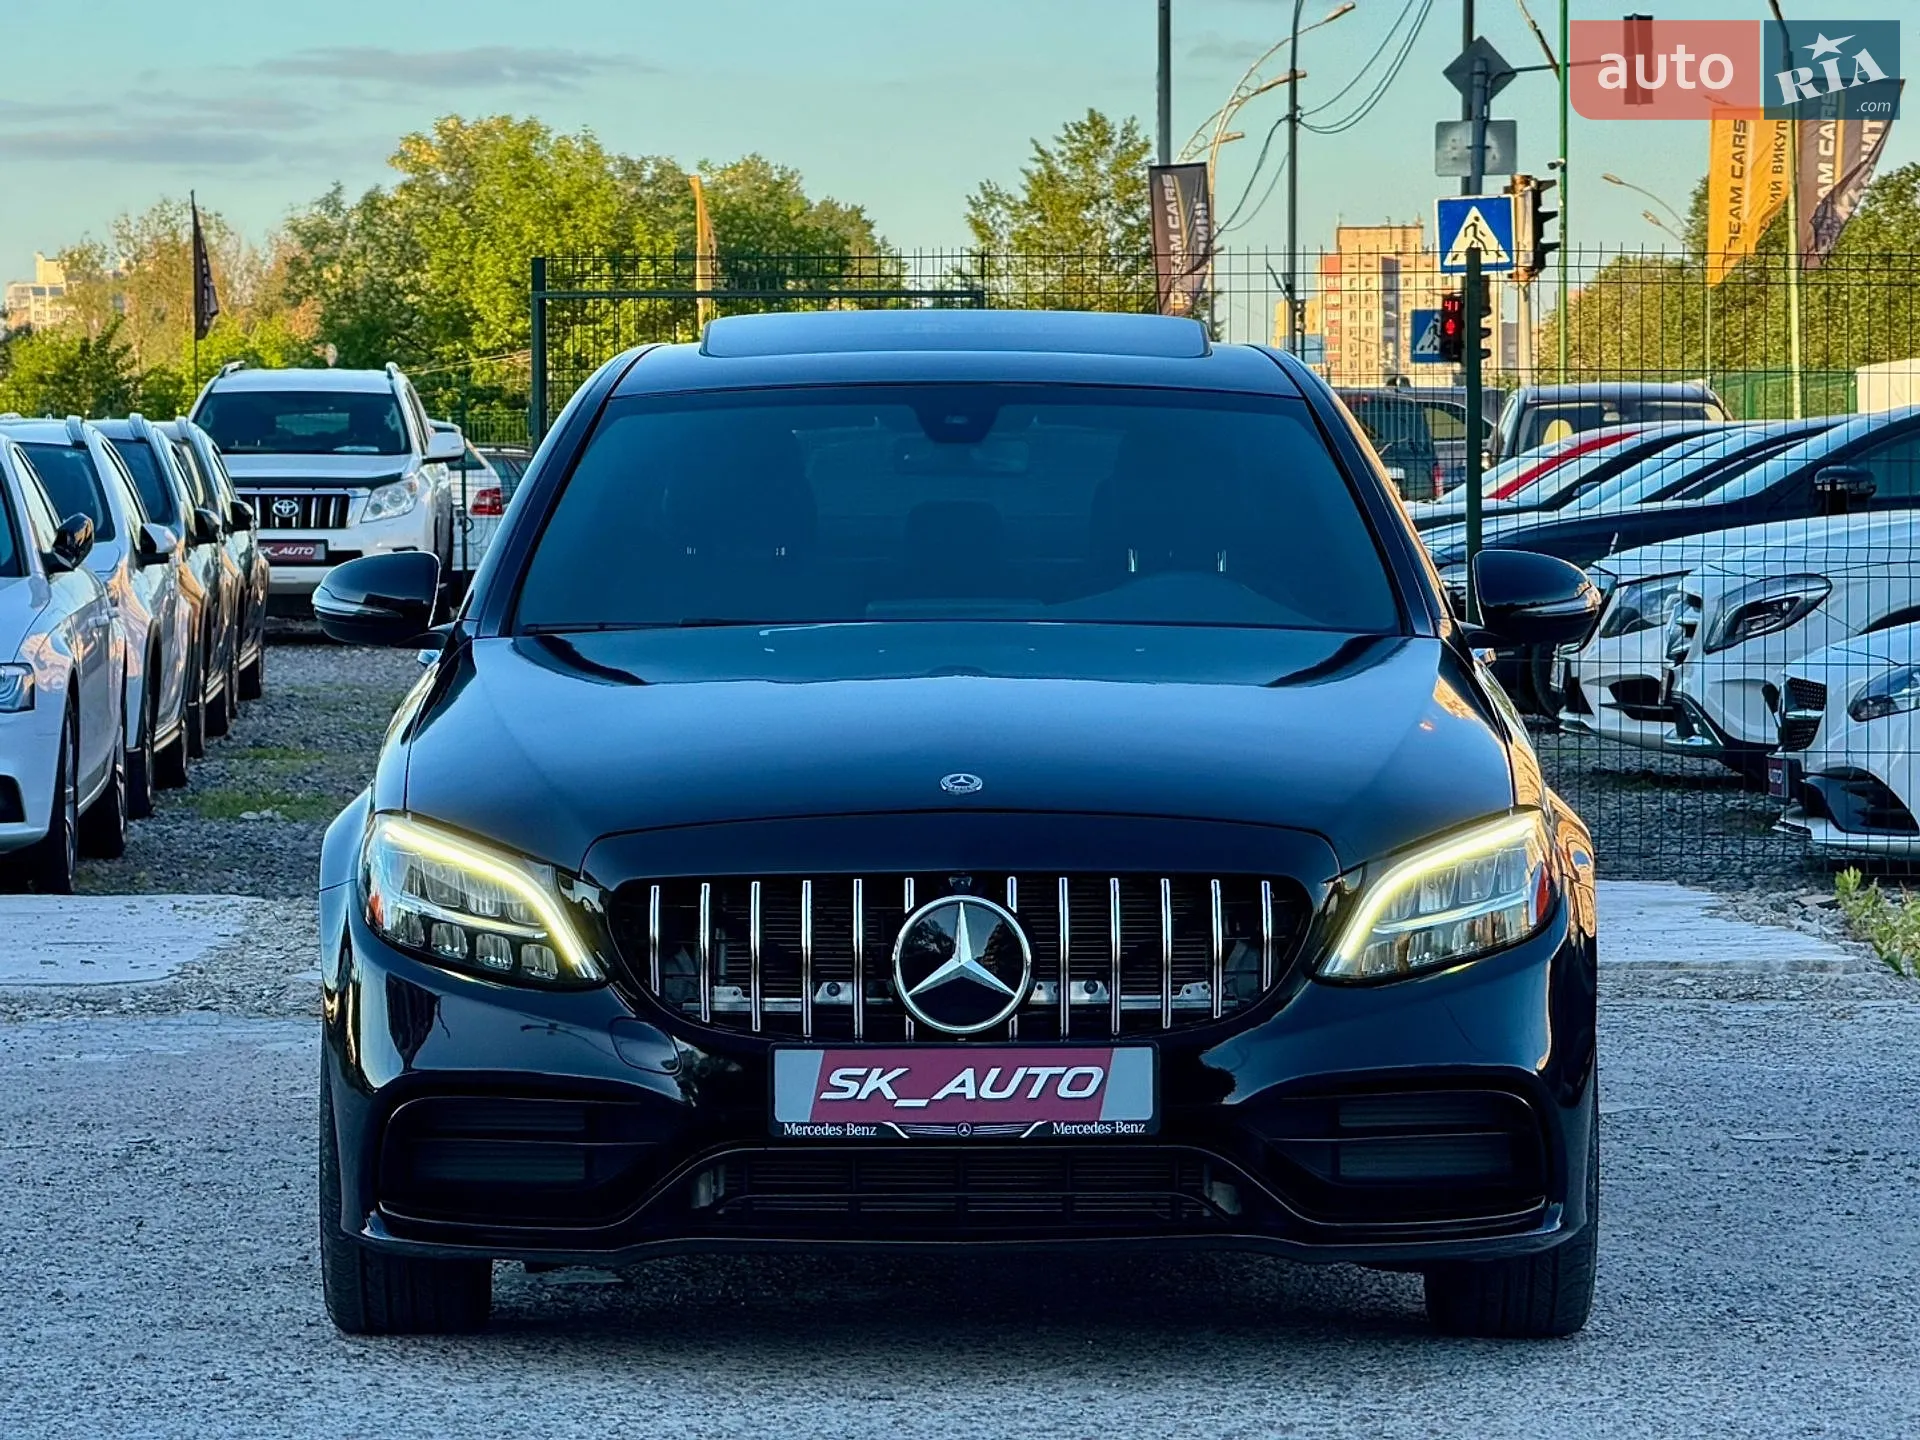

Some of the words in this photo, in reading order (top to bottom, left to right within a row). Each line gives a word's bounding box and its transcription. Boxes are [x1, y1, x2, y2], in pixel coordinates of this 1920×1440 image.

[1731, 119, 1747, 179] CARS
[1771, 120, 1788, 174] ВИКУП
[1161, 174, 1181, 230] CARS
[820, 1066, 1104, 1108] SK_AUTO
[783, 1121, 877, 1137] Mercedes-Benz
[1052, 1120, 1145, 1136] Mercedes-Benz
